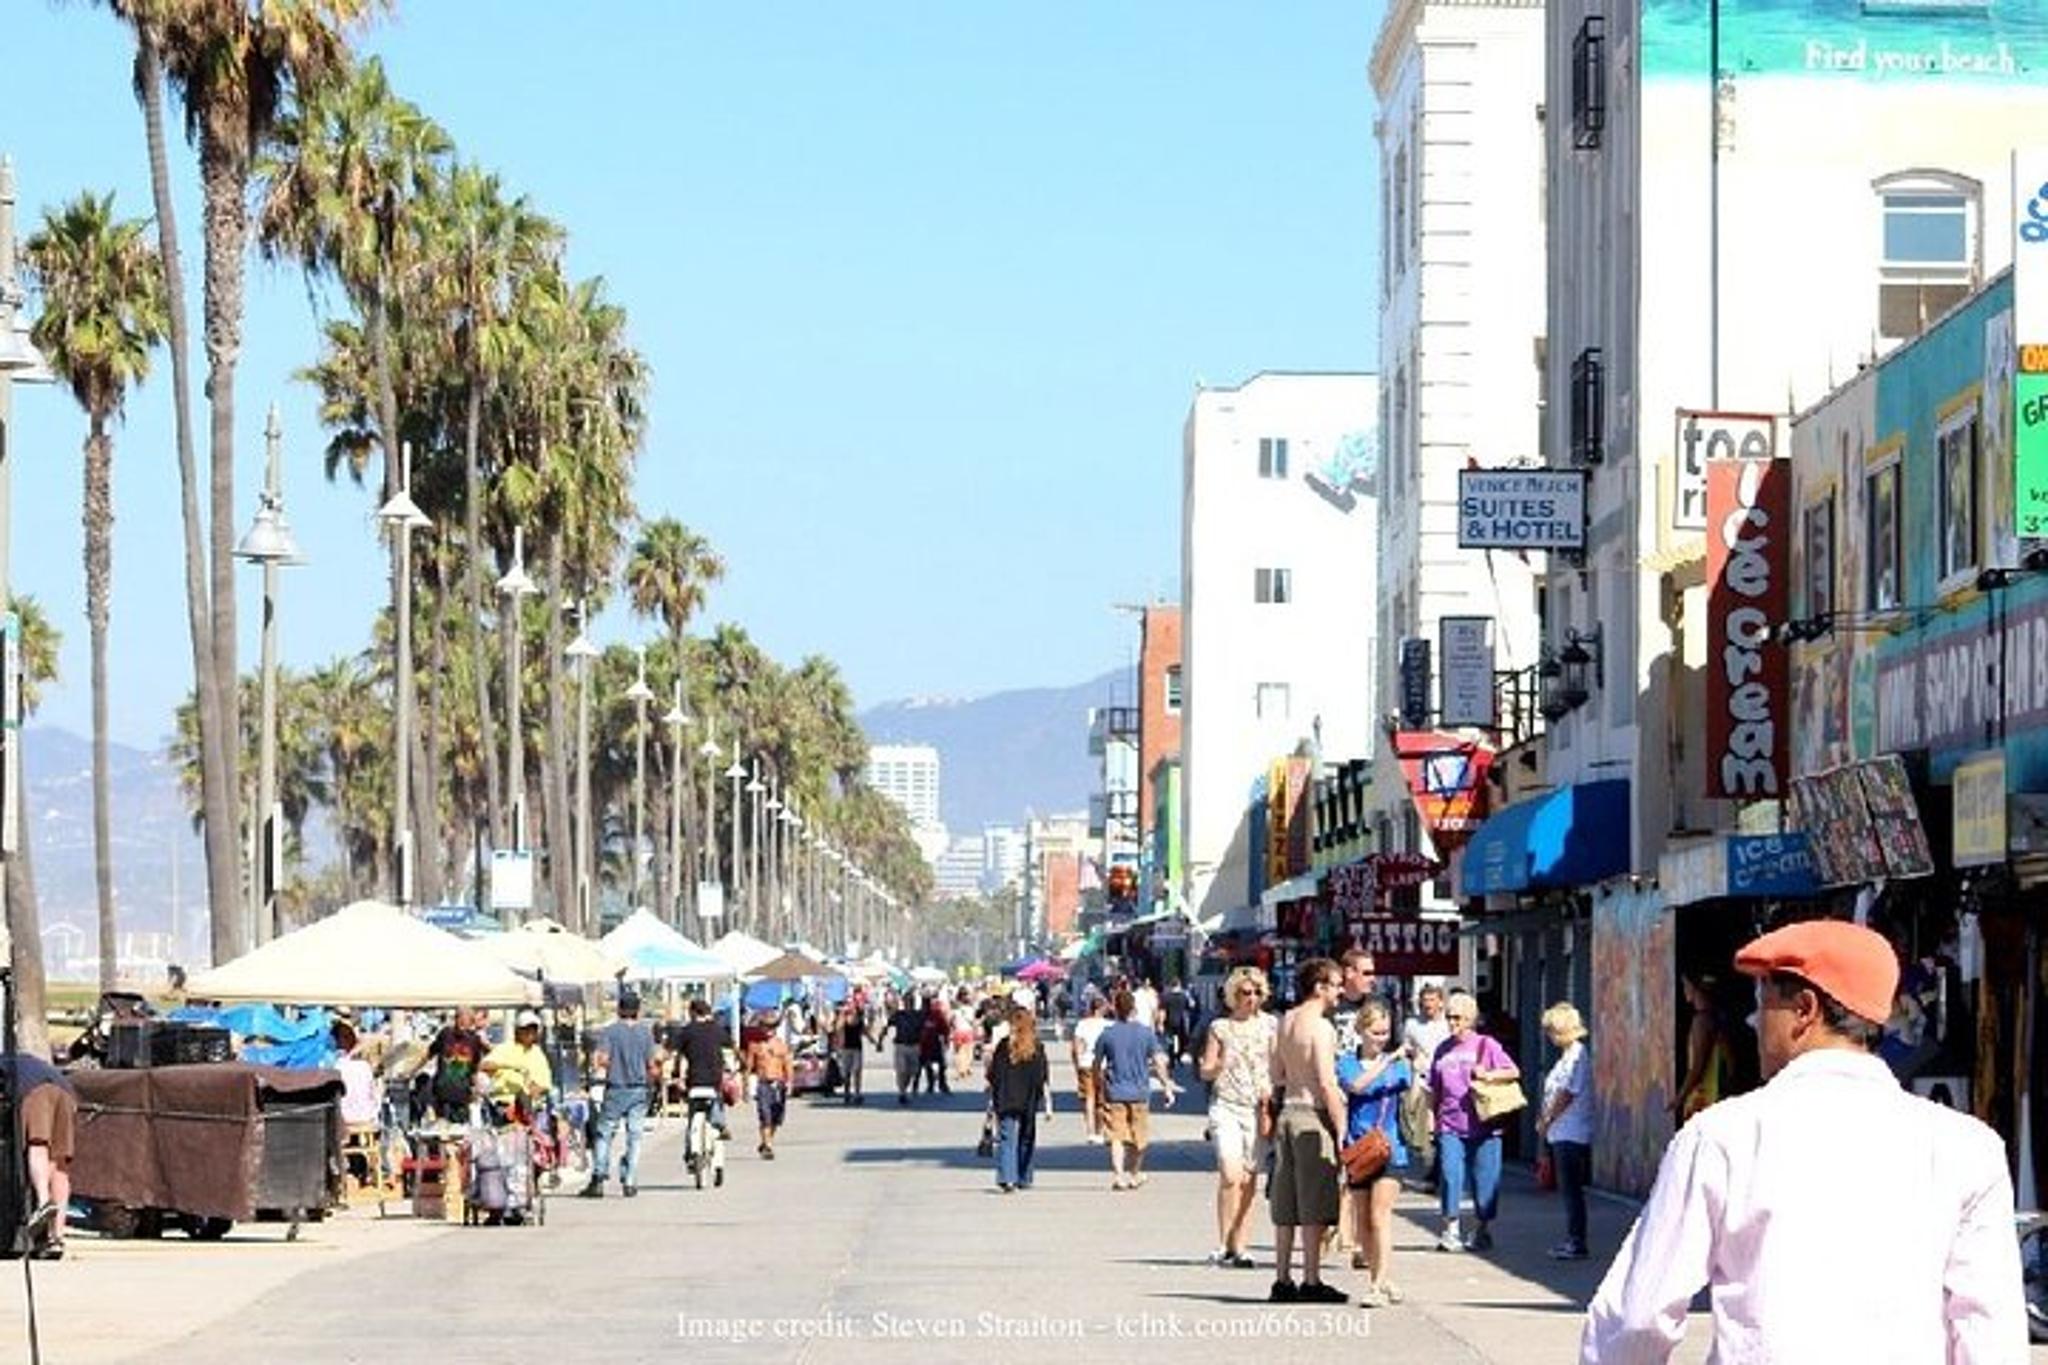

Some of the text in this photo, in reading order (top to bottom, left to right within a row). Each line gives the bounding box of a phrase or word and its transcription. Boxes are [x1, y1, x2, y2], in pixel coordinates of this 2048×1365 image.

[1803, 40, 1866, 70] Find
[1466, 478, 1521, 492] VENICE
[1463, 497, 1555, 518] SUITES
[1467, 519, 1580, 541] & HOTEL
[1348, 923, 1452, 953] TATTOO
